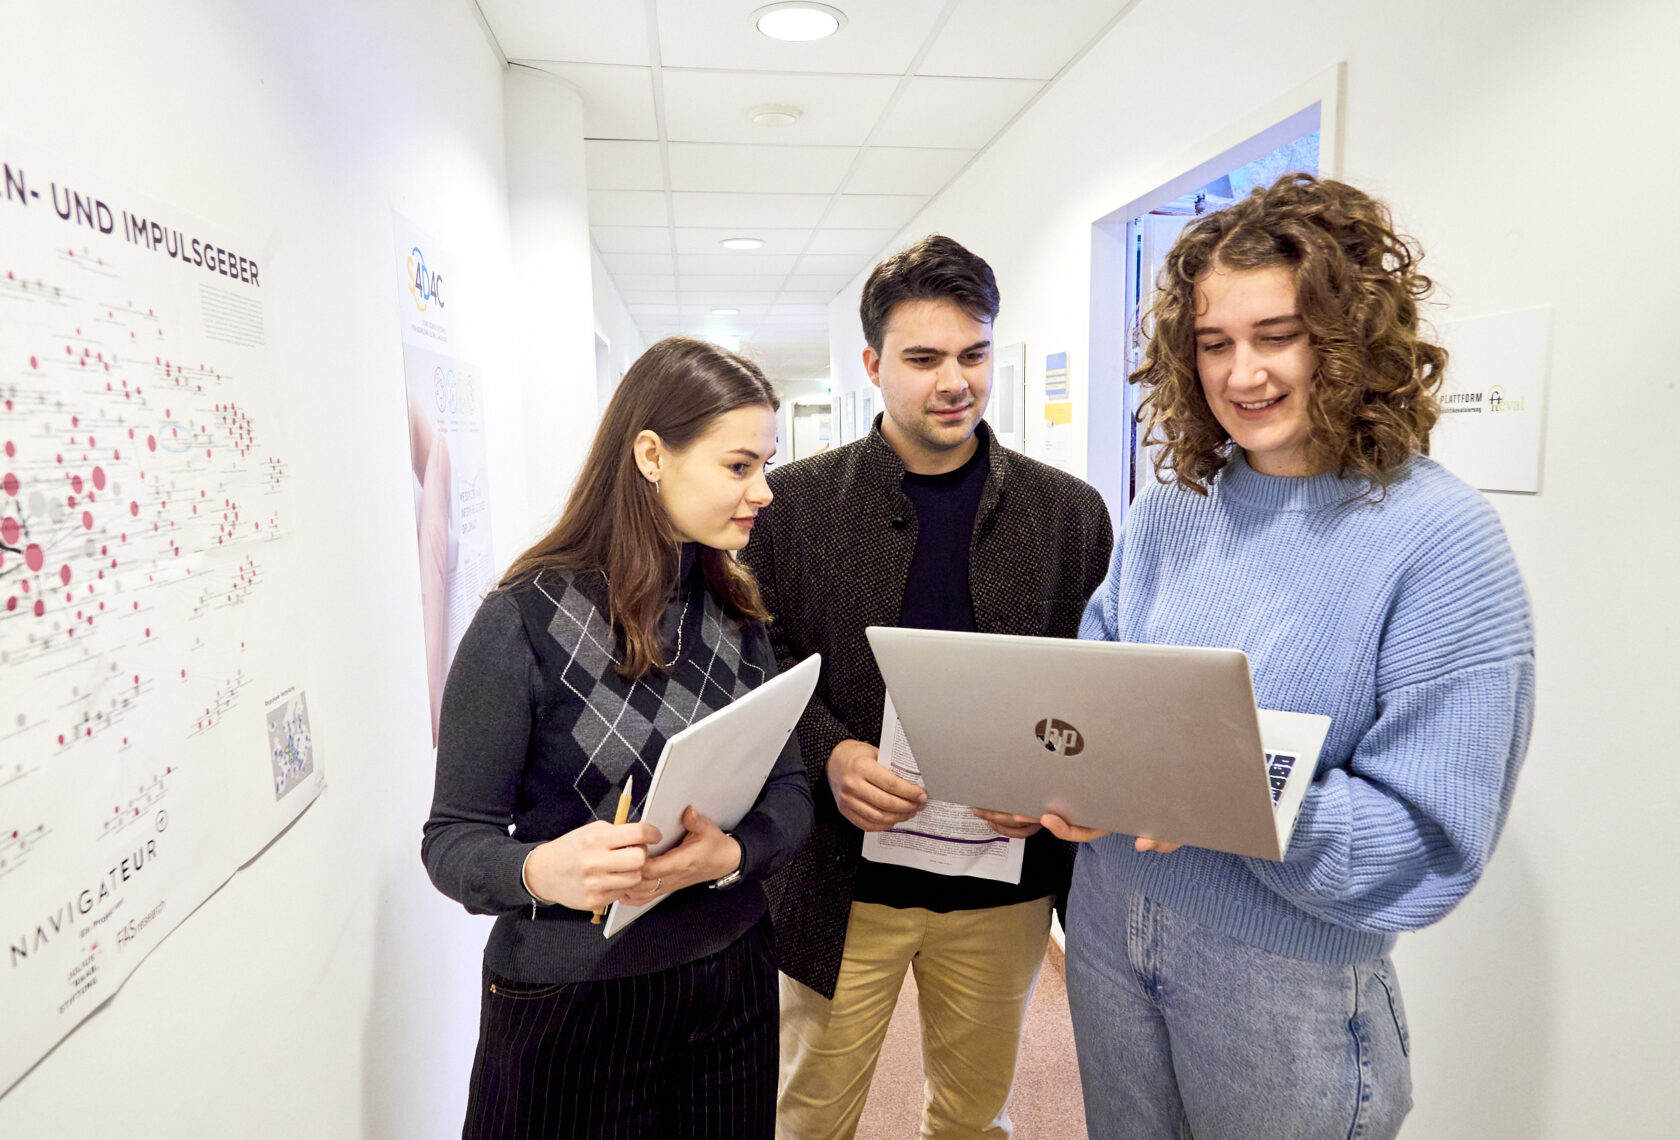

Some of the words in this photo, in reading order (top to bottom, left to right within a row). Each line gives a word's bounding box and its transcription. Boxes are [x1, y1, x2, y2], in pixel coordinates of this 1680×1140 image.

[0, 162, 40, 206] N-
[50, 182, 114, 234] UND
[123, 210, 260, 287] IMPULSGEBER
[406, 256, 444, 308] S4D4C
[1440, 392, 1483, 404] PLATTFORM
[1043, 718, 1078, 757] hp
[10, 838, 158, 968] NAVIGATEUR
